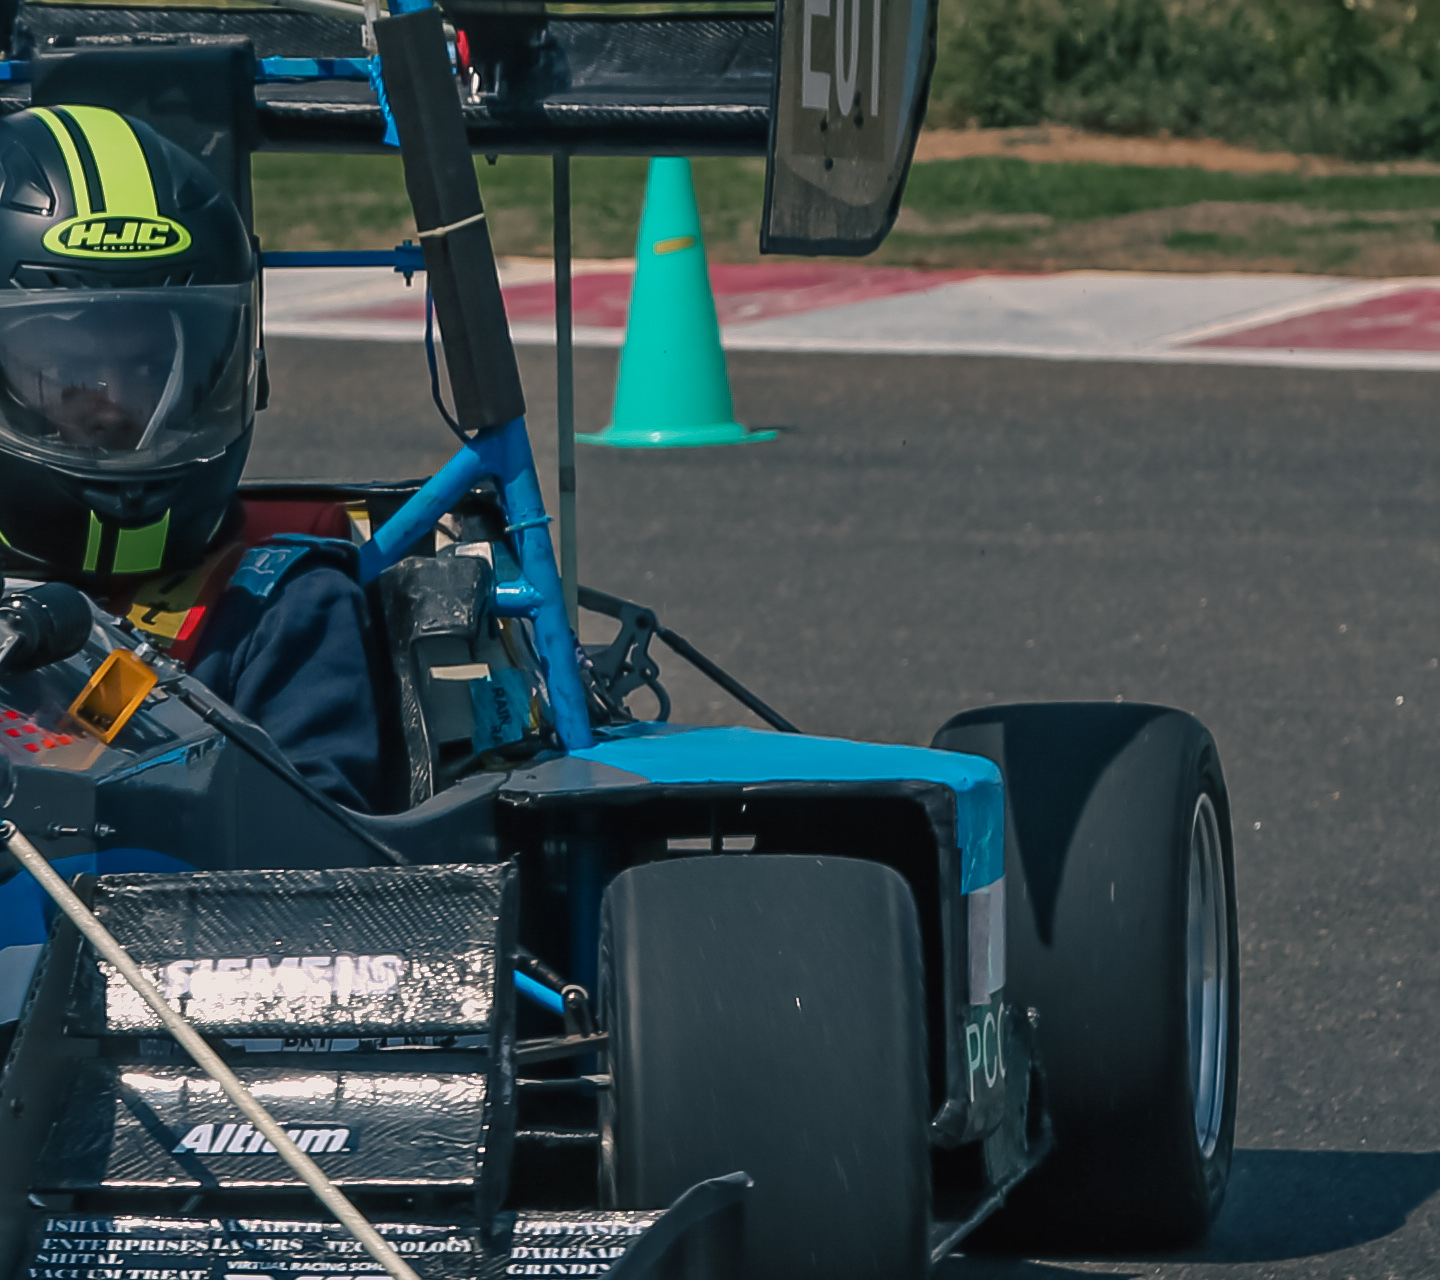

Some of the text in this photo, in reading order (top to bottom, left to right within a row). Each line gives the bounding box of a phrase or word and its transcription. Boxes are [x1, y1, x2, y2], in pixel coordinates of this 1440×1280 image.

[68, 222, 169, 247] HJC
[163, 954, 403, 998] SIEMENS
[42, 1237, 303, 1251] ENTERPRISES LASERS
[324, 1239, 473, 1253] TECNOLOGY
[35, 1253, 124, 1265] SHITAL
[290, 1262, 347, 1271] RACING
